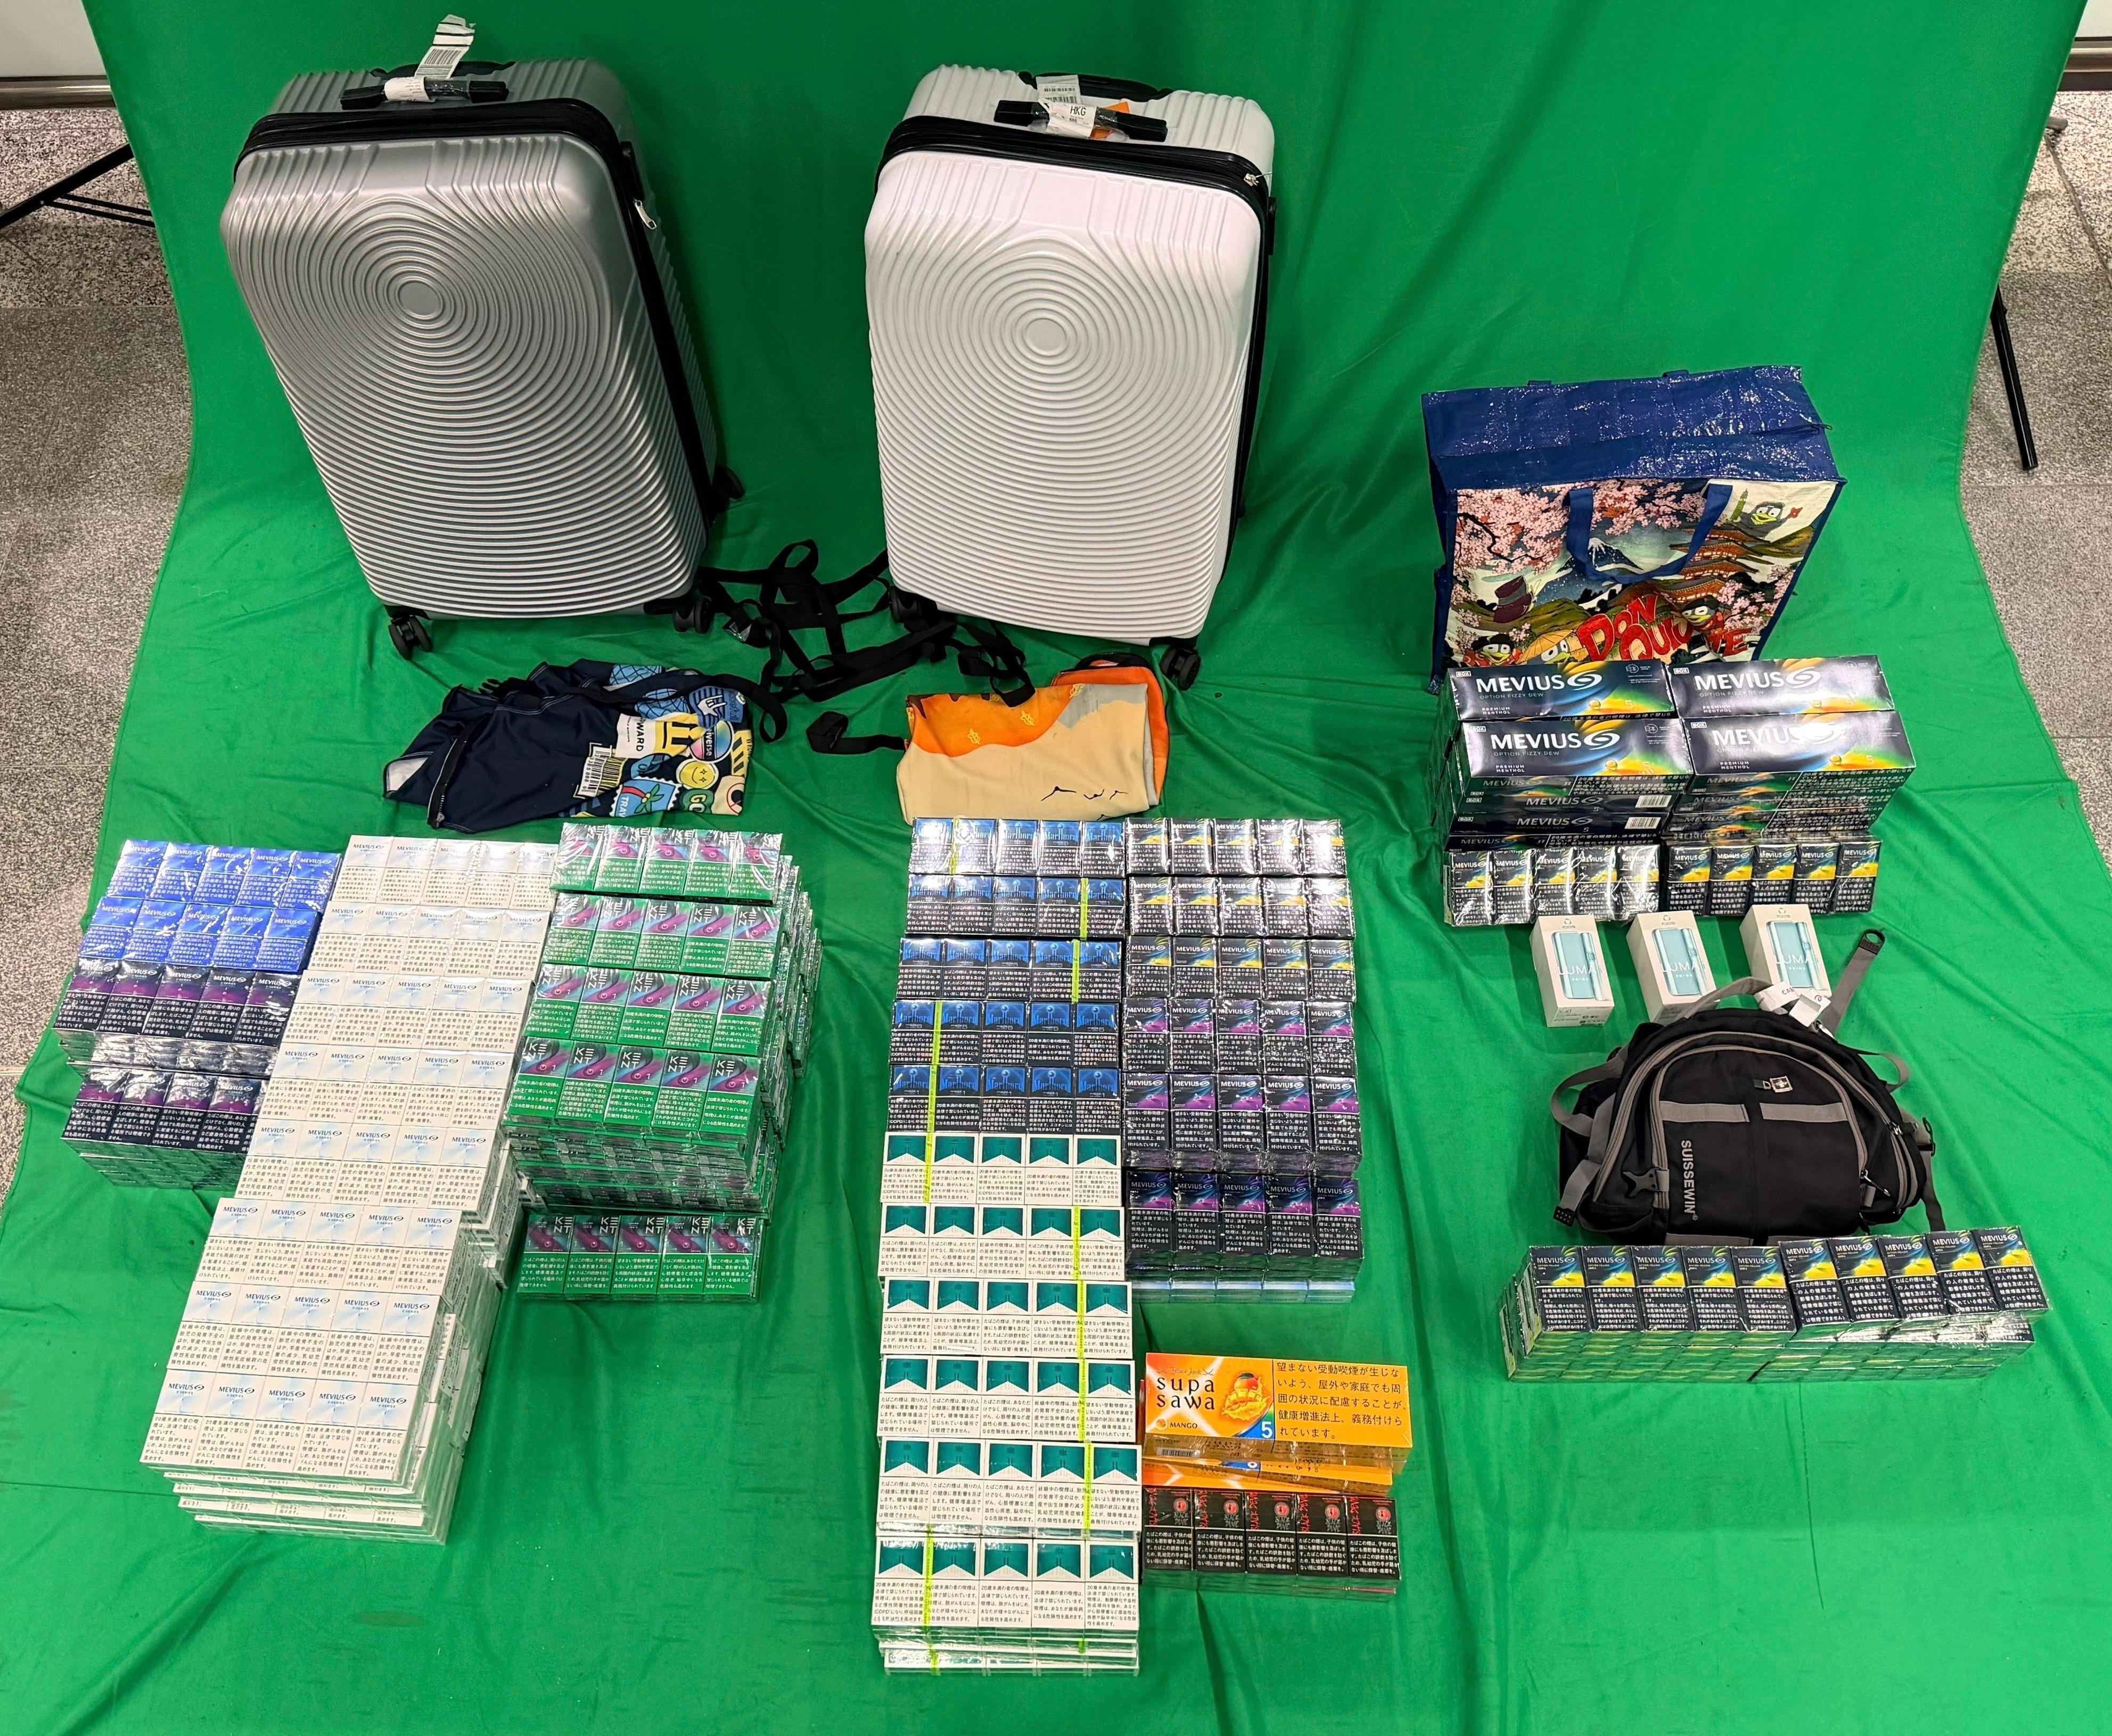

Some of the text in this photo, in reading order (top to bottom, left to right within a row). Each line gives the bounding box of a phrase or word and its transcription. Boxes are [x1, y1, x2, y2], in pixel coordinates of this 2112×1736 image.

[1070, 106, 1086, 116] HKG
[1476, 674, 1564, 693] MEVIUS
[1695, 672, 1785, 690] MEVIUS
[1491, 732, 1582, 750] MEVIUS
[1933, 1237, 1960, 1246] MEVIUS
[1980, 1235, 2007, 1243] MEVIUS
[1786, 1247, 1812, 1256] MEVIUS
[1836, 1244, 1862, 1253] MEVIUS
[1277, 1362, 1399, 1377] 望まない受動喫煙が生じな
[1157, 1377, 1214, 1395] supa
[1278, 1379, 1401, 1394] いよう、屋外や家庭でも周
[1157, 1394, 1214, 1410] sawa
[1278, 1394, 1406, 1410] 囲の状況に配慮することが、
[1279, 1410, 1402, 1426] 健康増進法上、義務付けら
[1261, 1421, 1272, 1438] 5
[1280, 1427, 1335, 1439] れています。
